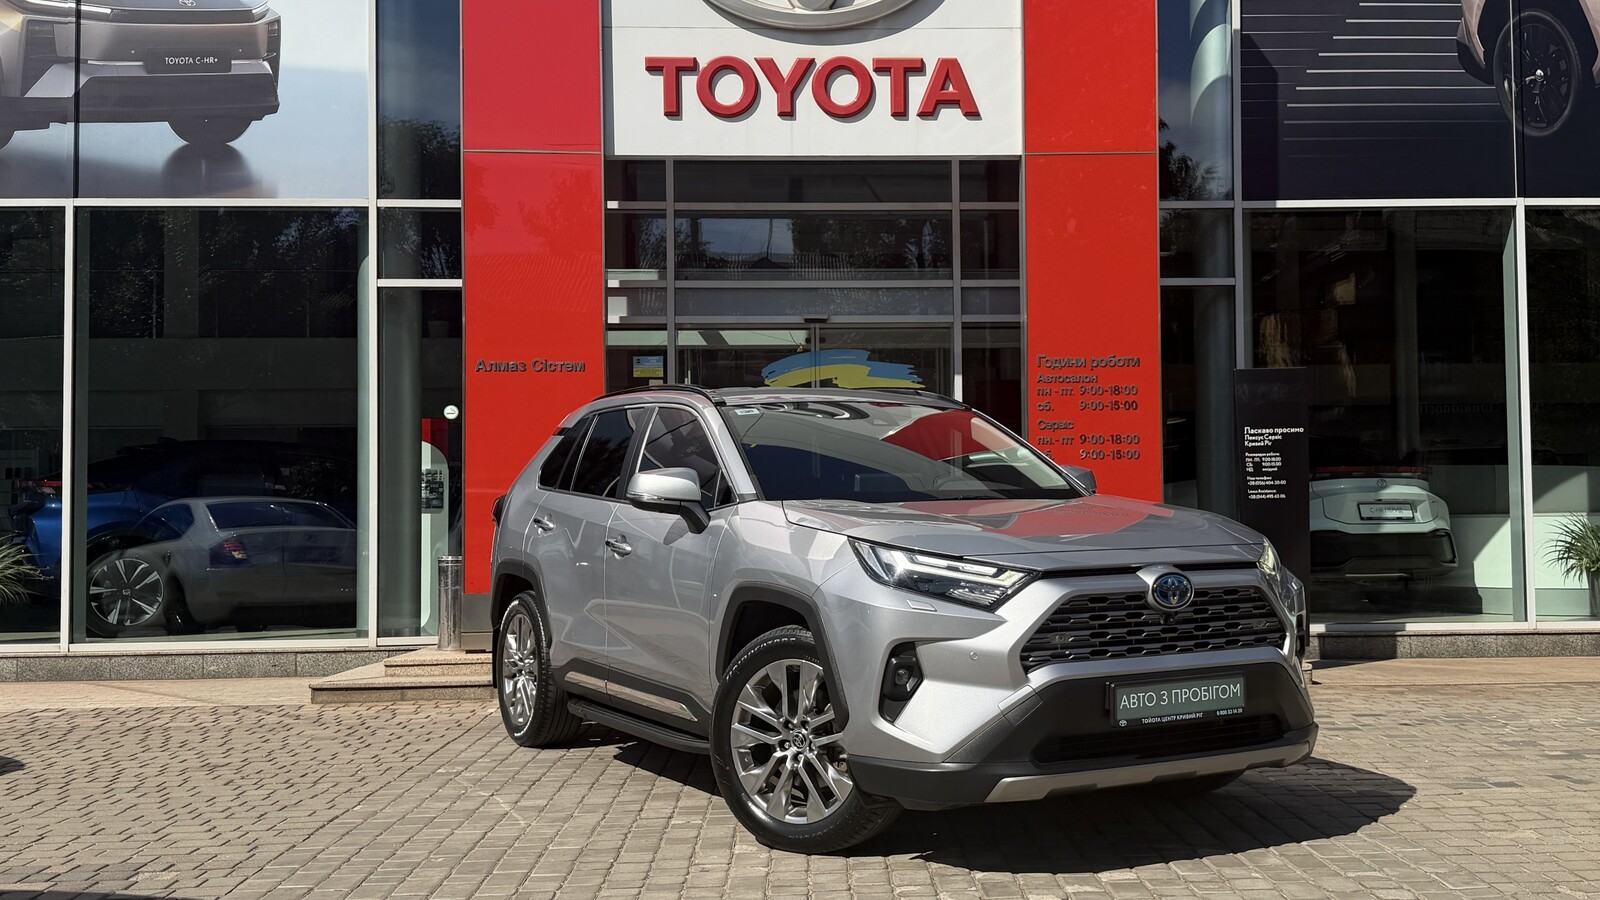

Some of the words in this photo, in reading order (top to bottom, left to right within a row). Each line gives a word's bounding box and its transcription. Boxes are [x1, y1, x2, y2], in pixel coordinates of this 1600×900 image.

[165, 57, 193, 65] TOYOTA
[195, 56, 218, 65] C-HR+
[645, 56, 981, 119] TOYOTA
[476, 358, 526, 373] Алмаз
[531, 358, 586, 373] Сістем
[1037, 355, 1087, 370] Години
[1090, 355, 1141, 371] роботи
[1037, 374, 1098, 384] Автосалон
[1079, 385, 1138, 396] 9:00-18:00
[1037, 401, 1054, 412] сб.
[1079, 400, 1139, 411] 9:00-15:00
[1037, 419, 1075, 432] Сервіс
[1244, 426, 1274, 434] Ласкаво
[1079, 434, 1140, 445] 9:00-18:00
[1079, 449, 1140, 460] 9:00-15:00
[1120, 692, 1156, 709] АВТО
[1172, 683, 1240, 703] ПРОБІГОМ
[1176, 712, 1196, 720] КРИВИЙ
